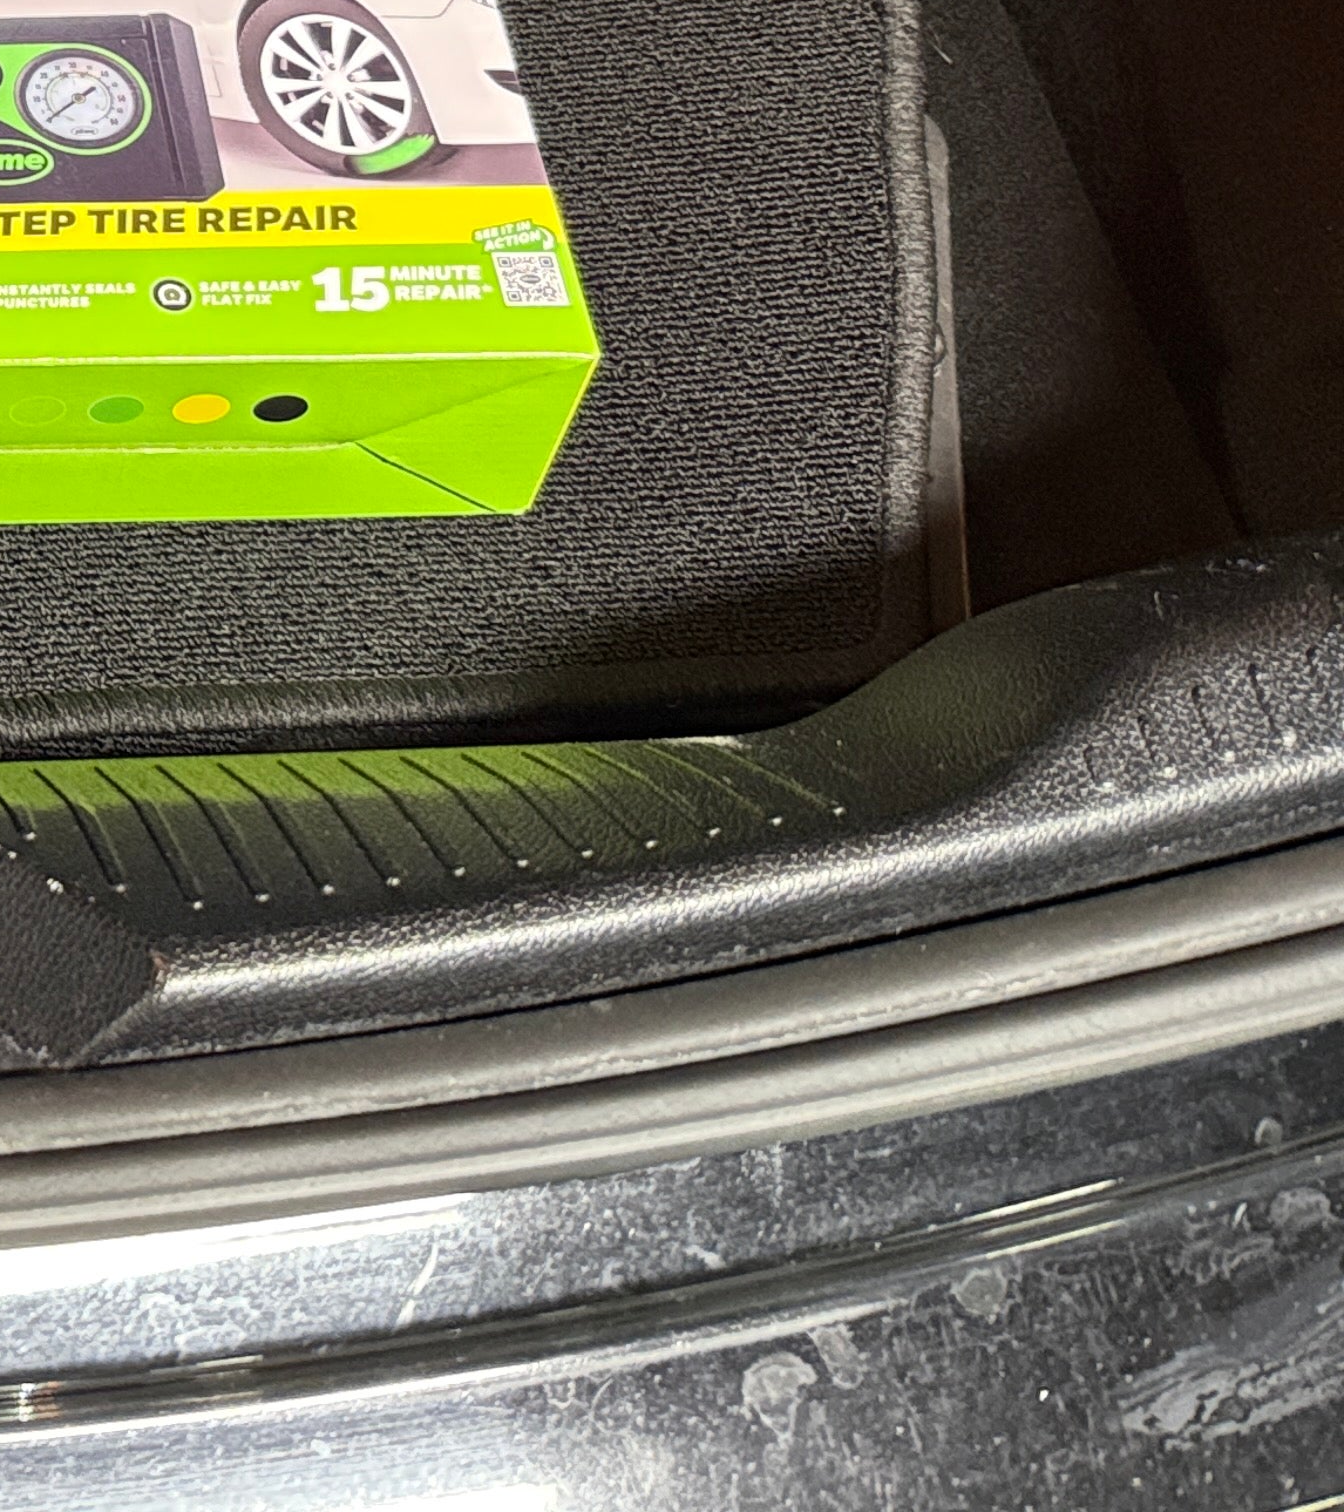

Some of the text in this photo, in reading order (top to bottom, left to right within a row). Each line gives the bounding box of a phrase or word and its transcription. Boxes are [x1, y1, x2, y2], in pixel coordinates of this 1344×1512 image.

[87, 207, 186, 235] TIRE
[197, 204, 359, 233] REPAIR
[473, 219, 531, 241] SEE IT IN
[483, 229, 542, 252] ACTION
[85, 282, 136, 294] SEALS
[198, 280, 302, 293] SAFE & EASY
[312, 264, 482, 312] 15 MINUTE
[201, 293, 273, 306] FLAT FIX
